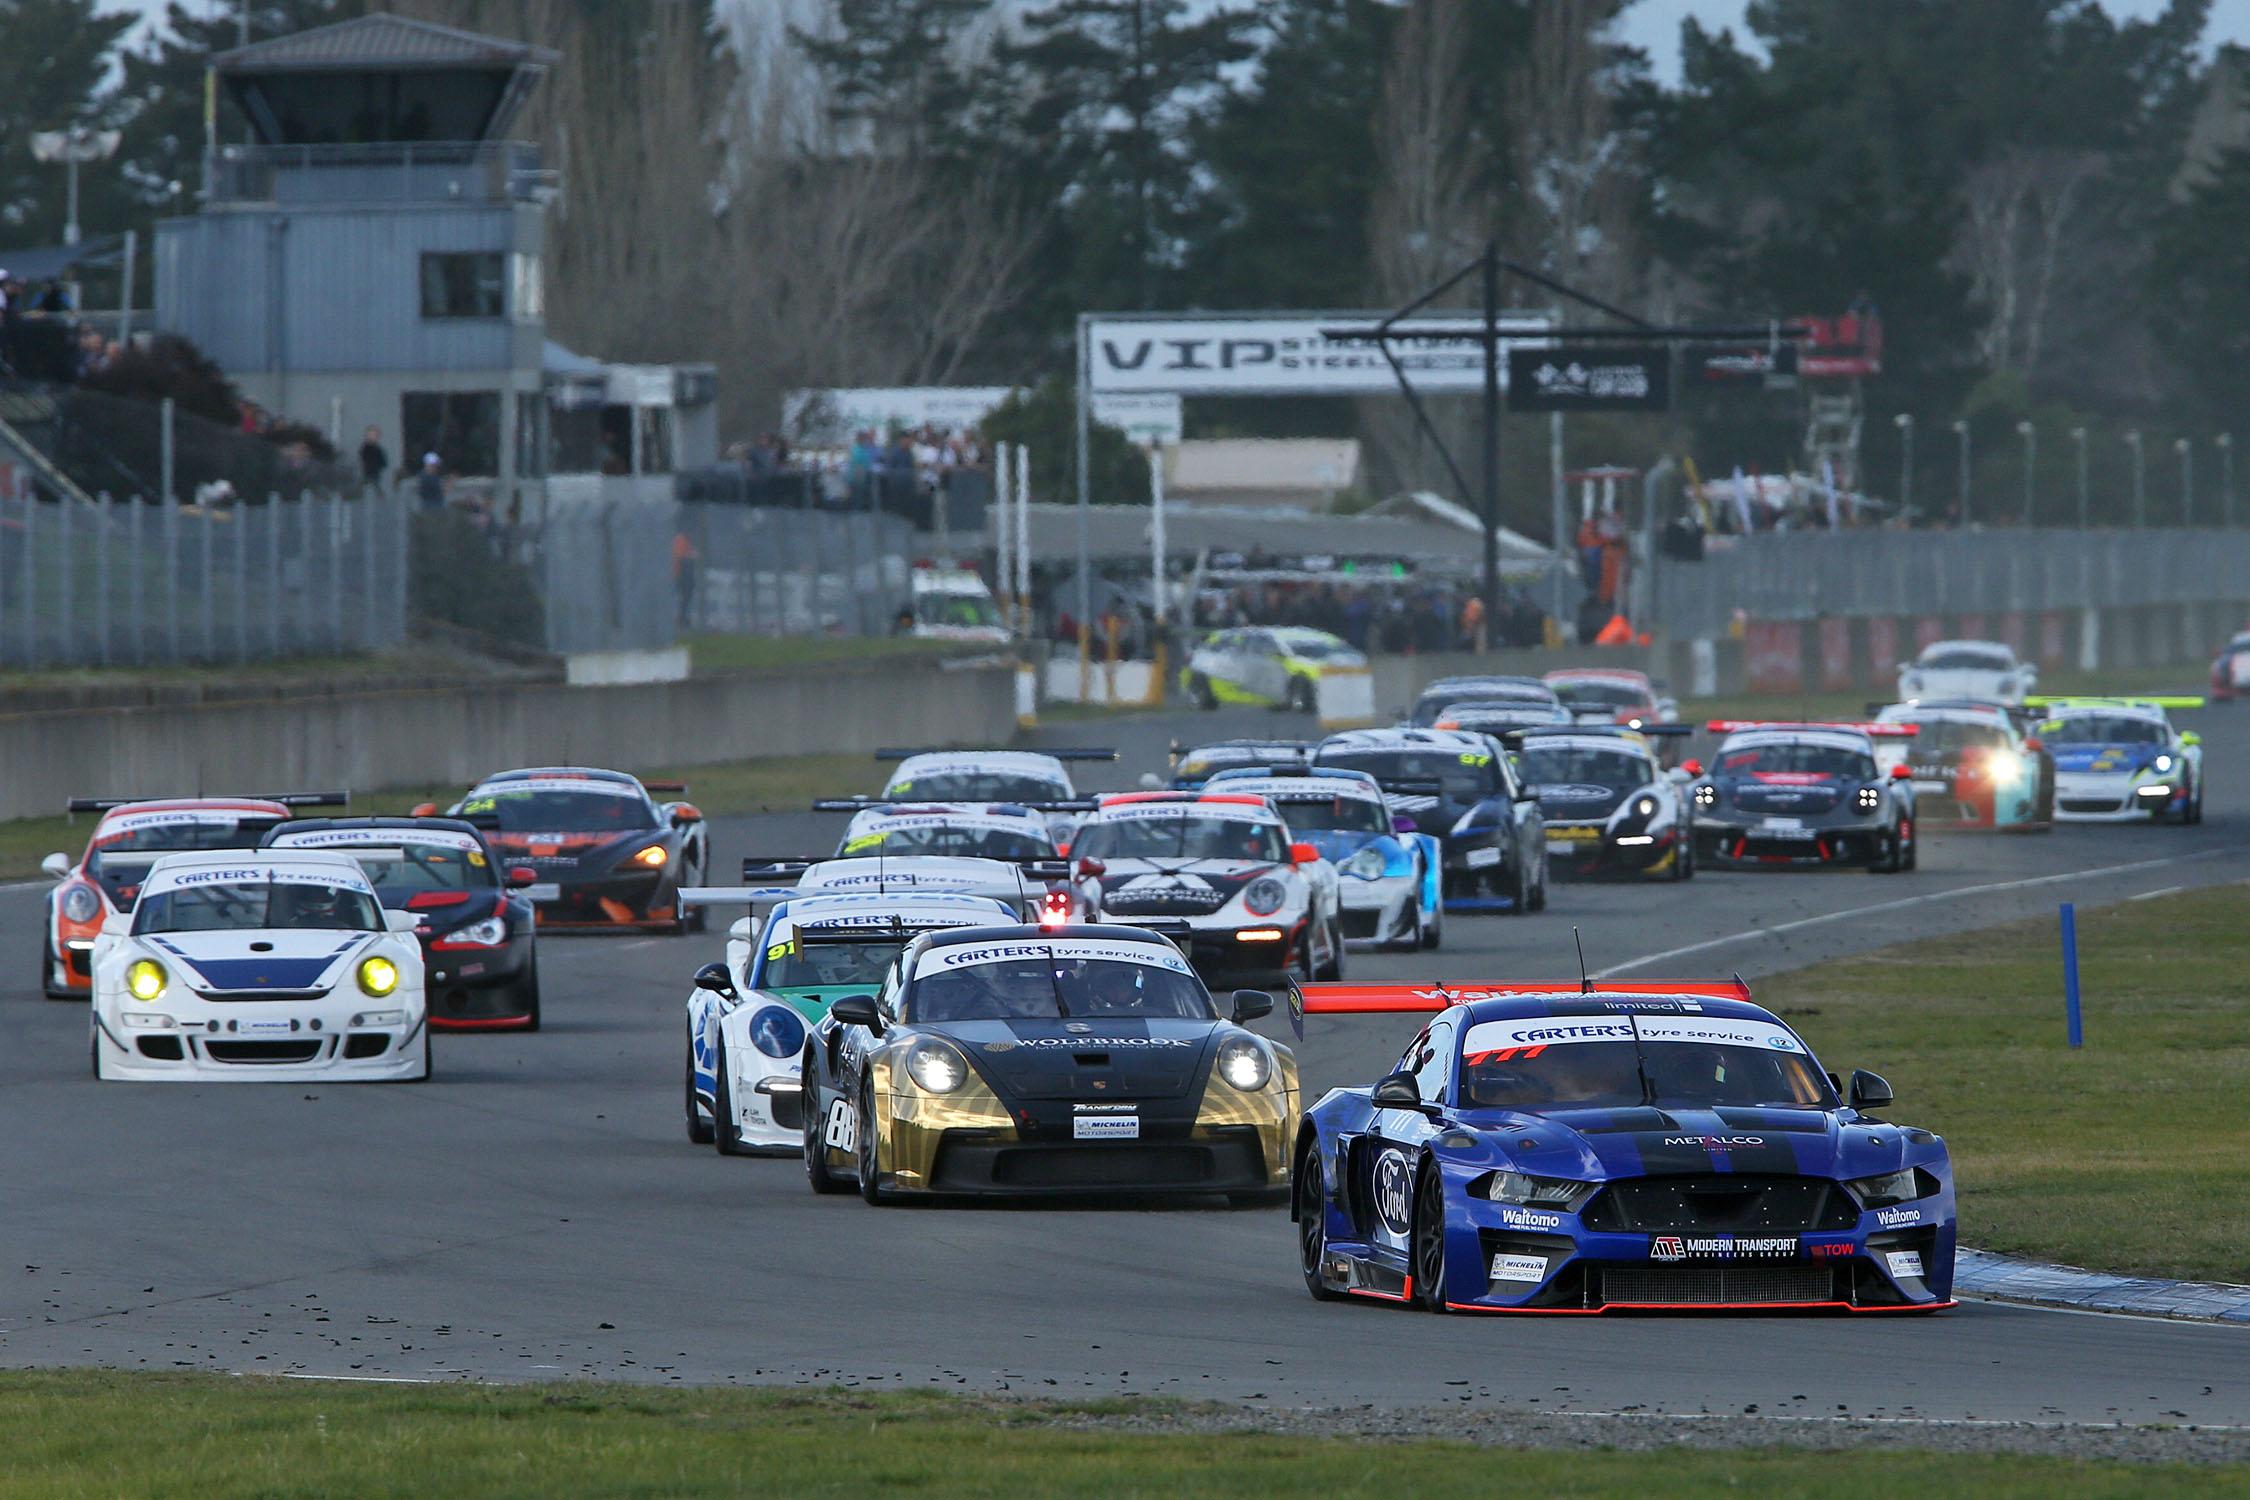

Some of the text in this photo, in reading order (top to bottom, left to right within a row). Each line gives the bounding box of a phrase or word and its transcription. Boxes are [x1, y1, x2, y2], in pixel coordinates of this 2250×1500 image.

[1102, 338, 1276, 371] VIP
[174, 868, 260, 885] CARTER'S
[944, 945, 1155, 965] CARTER'S tyre service
[1604, 1001, 1675, 1011] limited
[1511, 1024, 1754, 1042] CARTER'S tyre service
[1015, 1037, 1193, 1048] WOLFBROOK
[1664, 1136, 1764, 1145] METALCO
[1381, 1159, 1409, 1224] Ford
[1502, 1208, 1560, 1227] Waitomo
[1876, 1207, 1921, 1225] Waitomo
[1686, 1238, 1798, 1252] MODERN TRANSPORT
[1823, 1243, 1855, 1256] TOW
[1505, 1261, 1545, 1270] MICHELIN
